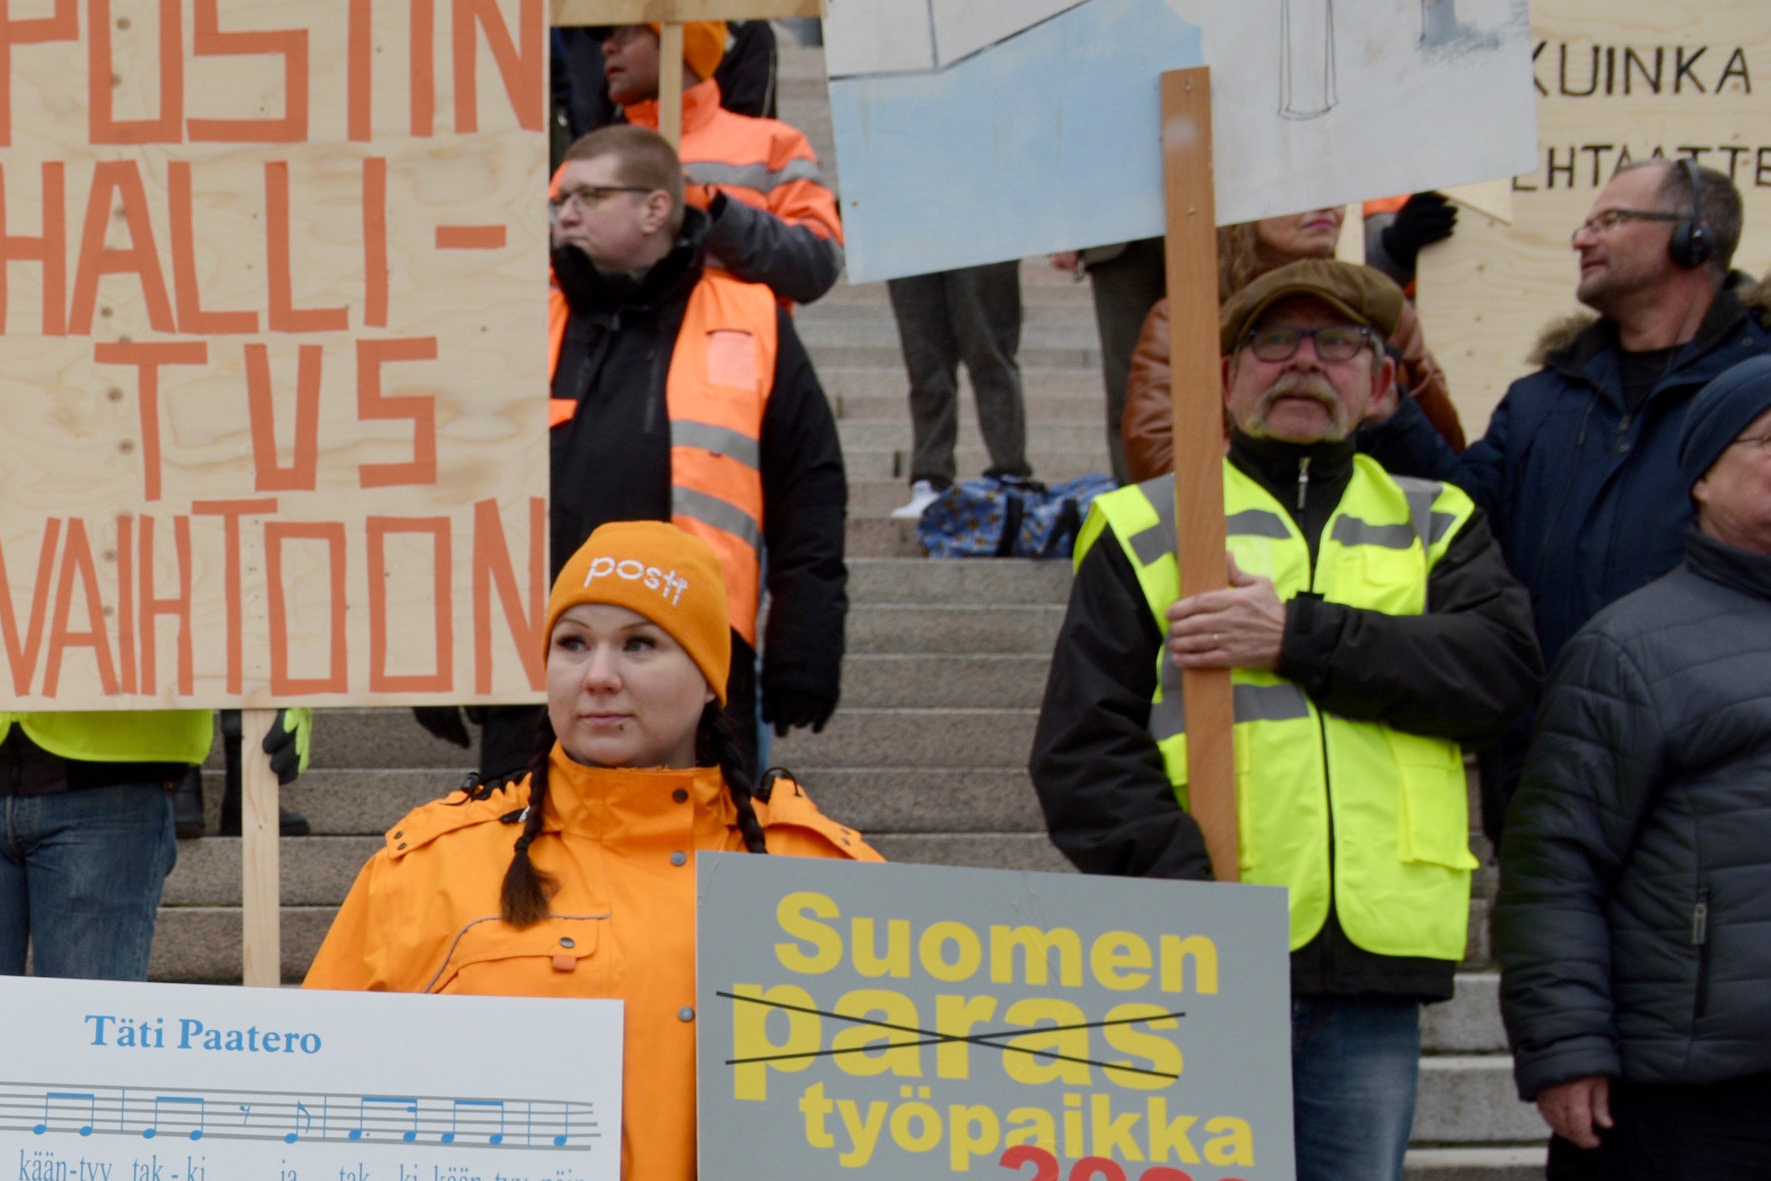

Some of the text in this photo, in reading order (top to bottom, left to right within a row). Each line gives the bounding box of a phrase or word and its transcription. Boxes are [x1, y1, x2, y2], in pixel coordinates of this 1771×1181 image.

[583, 556, 689, 607] posti
[773, 890, 1219, 995] Suomen
[84, 1014, 322, 1054] Täti Paatero
[732, 982, 1185, 1102] paras
[798, 1080, 1256, 1172] työpaikka
